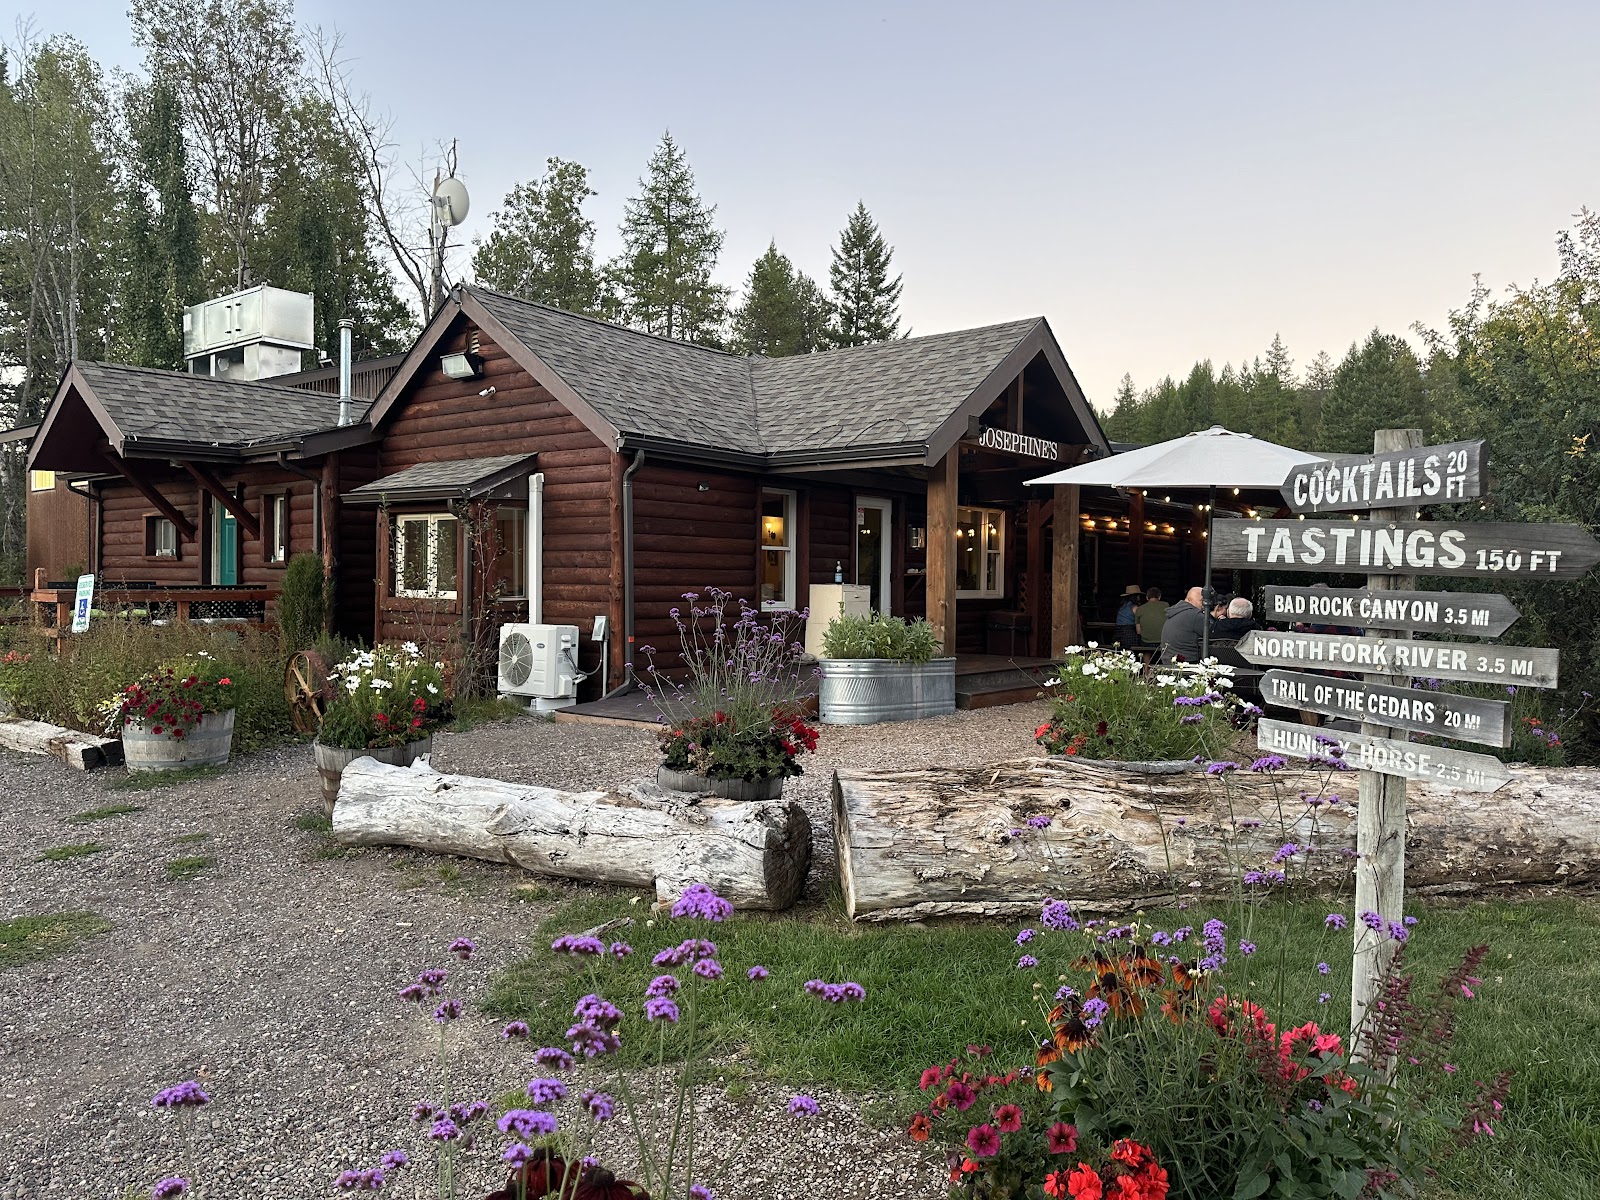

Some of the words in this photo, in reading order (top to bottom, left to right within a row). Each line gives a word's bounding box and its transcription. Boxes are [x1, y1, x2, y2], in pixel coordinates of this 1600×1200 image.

[979, 427, 1058, 460] JOSEPHINE'S
[1446, 450, 1468, 474] 20
[1293, 454, 1442, 506] COCKTAILS
[1446, 474, 1467, 499] FT
[1241, 526, 1467, 569] TASTINGS
[1475, 549, 1522, 572] 150
[1529, 550, 1562, 573] FT
[1274, 594, 1306, 614] BAD
[1309, 595, 1354, 617] ROCK
[1359, 597, 1439, 623] CANYON
[1444, 607, 1468, 625] 3.5
[1471, 609, 1490, 627] MI
[1253, 636, 1323, 661] NORTH
[1328, 642, 1388, 665] FORK
[1395, 645, 1468, 671] RIVER
[1476, 656, 1506, 674] 3.5
[1510, 659, 1534, 676] MI
[1271, 678, 1310, 702] TRAIL
[1314, 684, 1333, 705] OF
[1335, 688, 1365, 712] THE
[1367, 693, 1435, 724] CEDARS
[1444, 710, 1461, 728] 20
[1464, 713, 1481, 730] MI
[1359, 743, 1431, 776] HORSE
[1436, 763, 1461, 781] 2.5
[1465, 768, 1486, 786] MI
